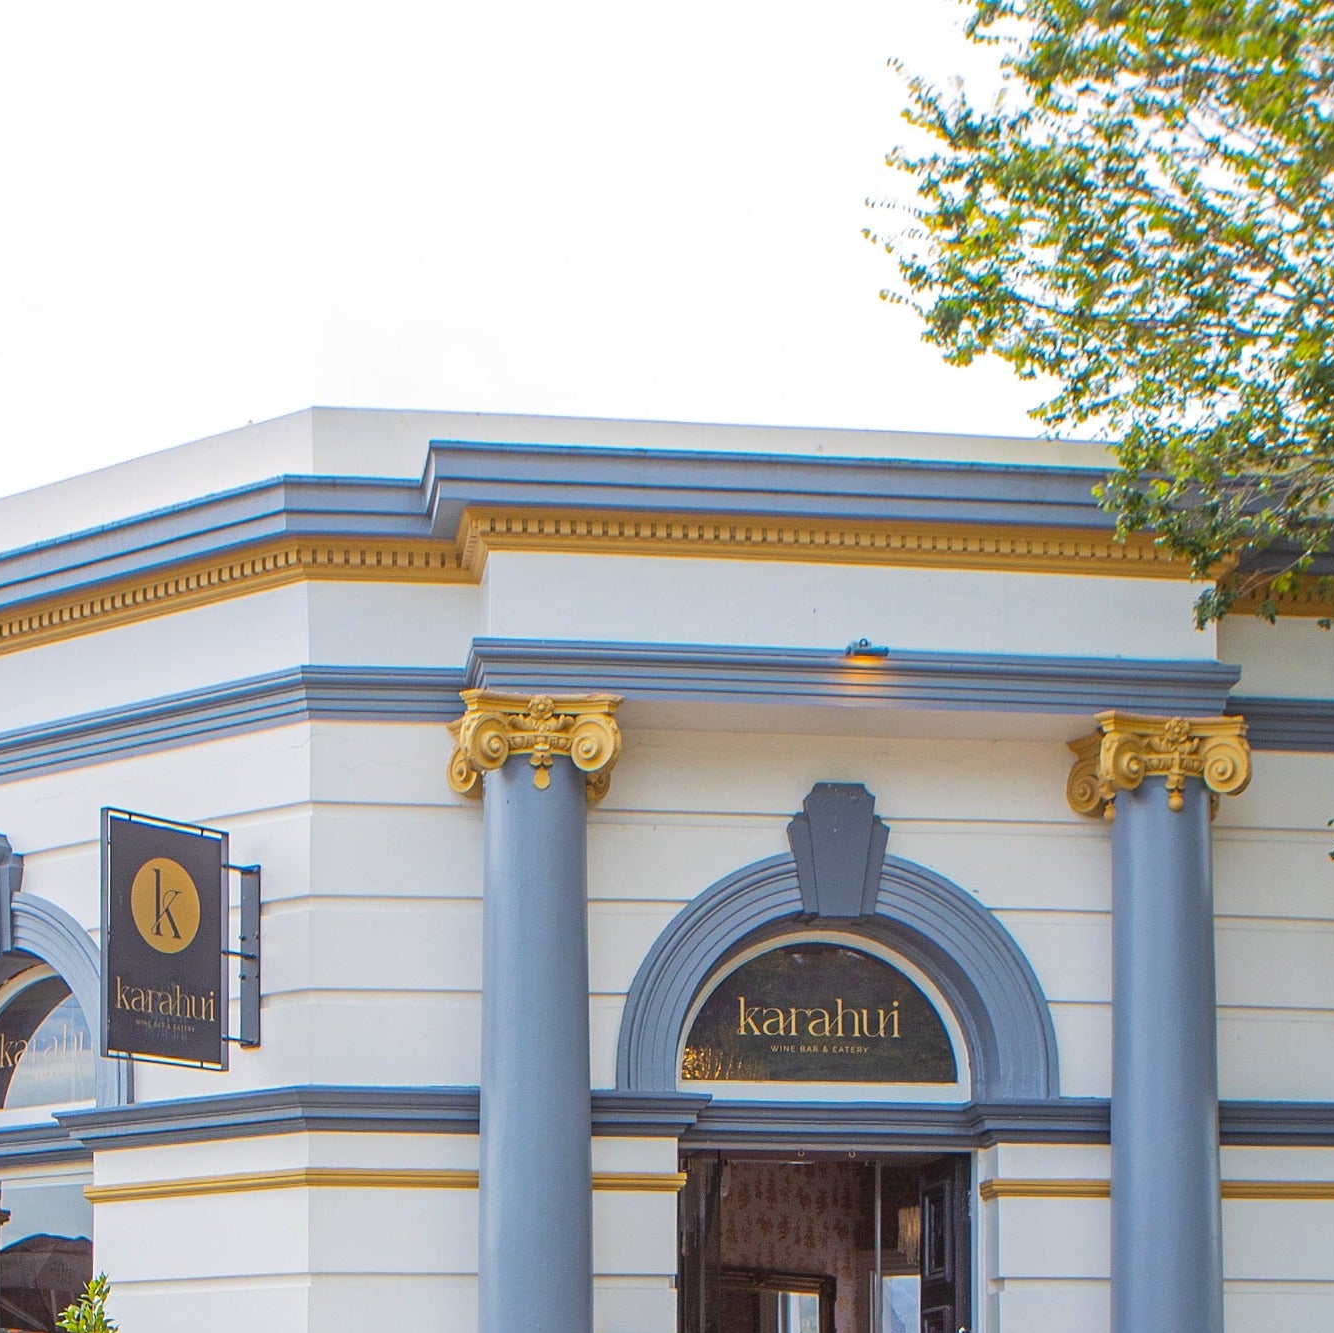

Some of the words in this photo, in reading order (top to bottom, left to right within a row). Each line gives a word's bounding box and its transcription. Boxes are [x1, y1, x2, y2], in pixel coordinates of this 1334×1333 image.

[115, 976, 215, 1022] karahui
[737, 996, 901, 1038] karahui
[770, 1044, 796, 1053] WINE
[800, 1045, 819, 1053] BAR
[832, 1045, 869, 1054] EATERY
